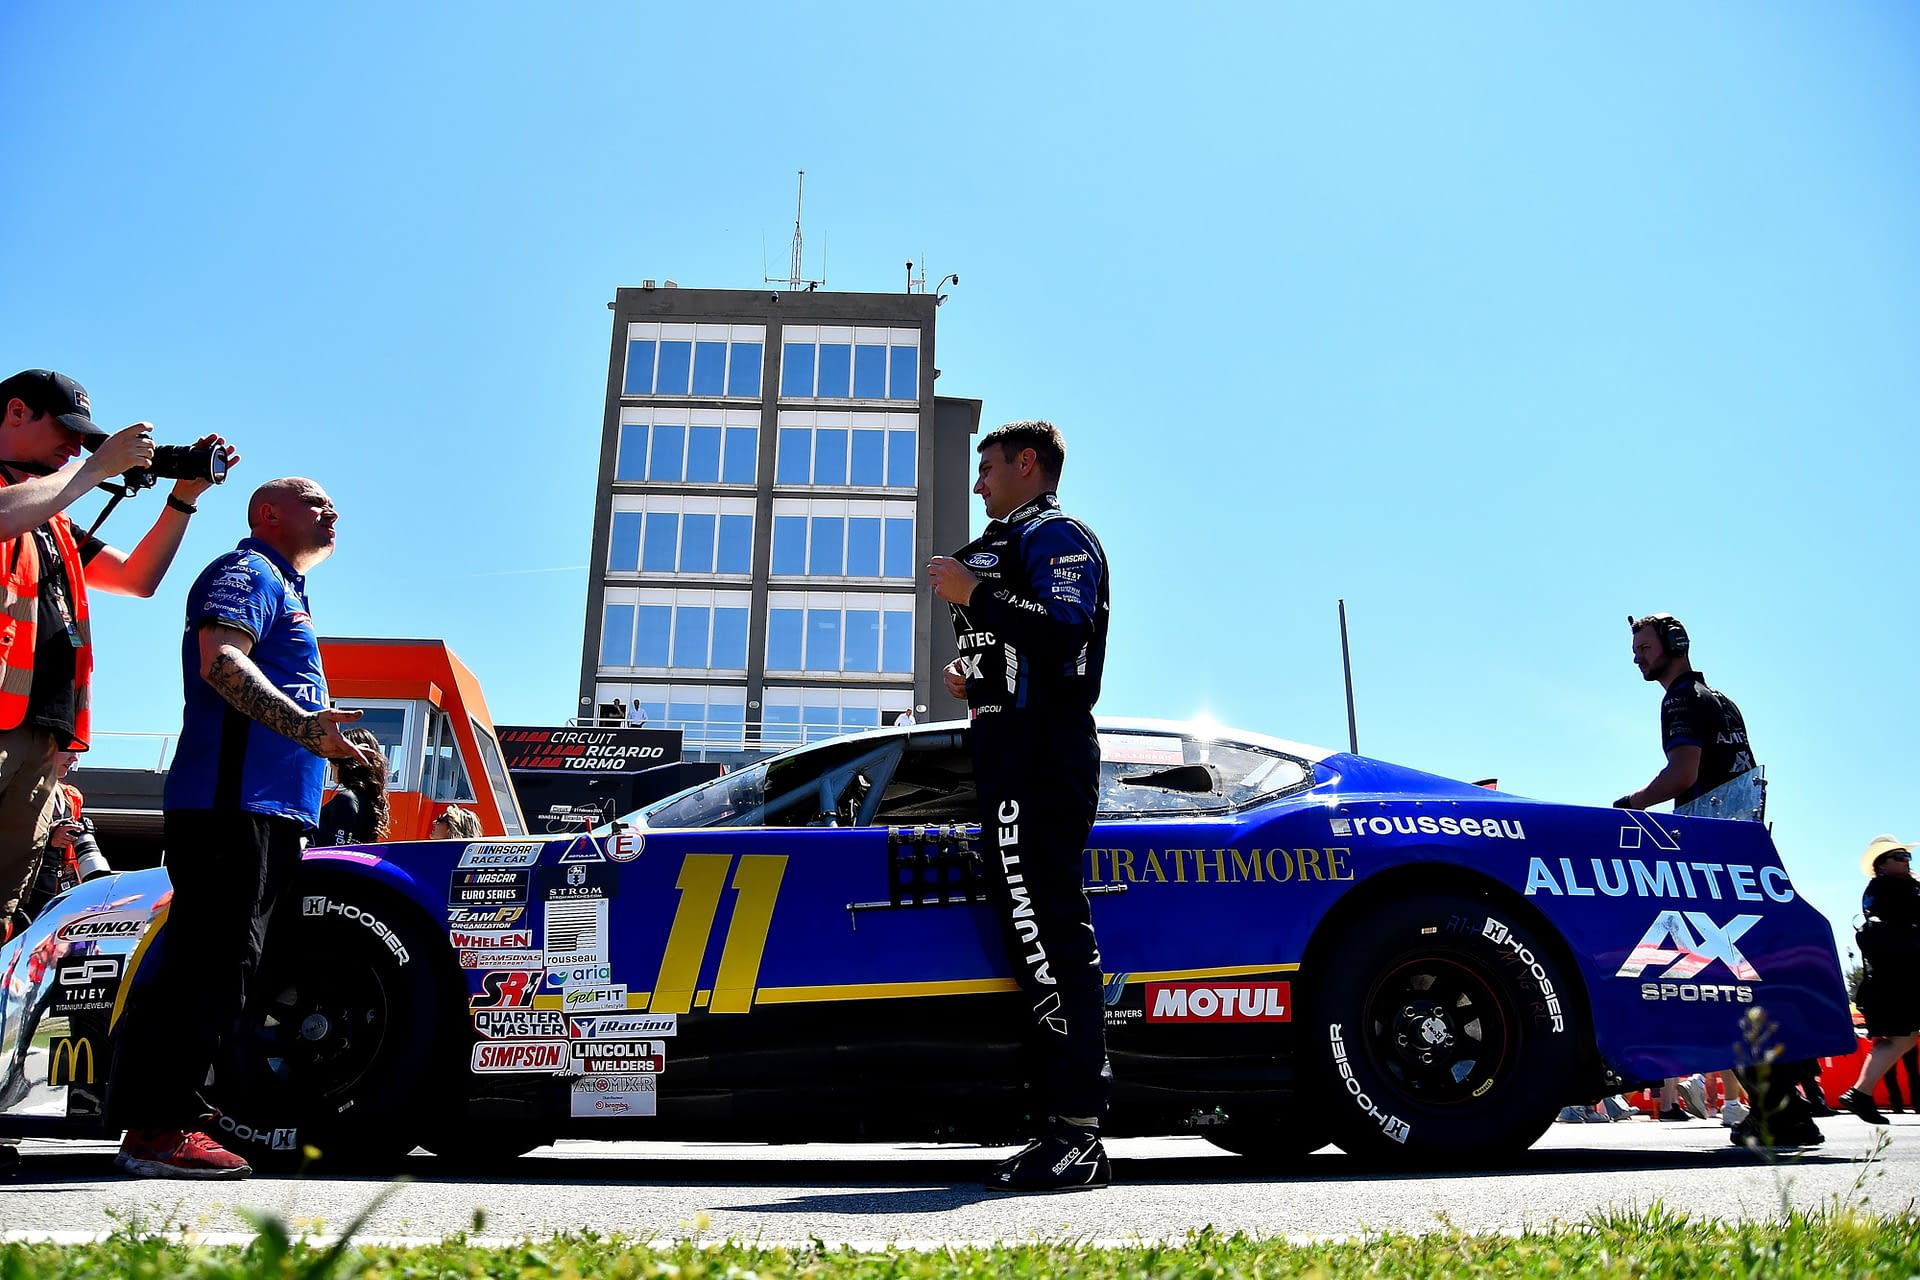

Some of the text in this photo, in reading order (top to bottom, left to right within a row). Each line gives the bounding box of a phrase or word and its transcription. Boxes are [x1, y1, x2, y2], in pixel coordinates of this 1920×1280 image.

[969, 556, 994, 568] Ford
[1059, 554, 1088, 564] NASCAR
[550, 731, 617, 745] CIRCUIT
[585, 745, 665, 759] RICARDO
[564, 757, 626, 771] TORMO
[1353, 815, 1526, 841] rousseau
[487, 845, 532, 855] NASCAR
[615, 835, 634, 855] E
[470, 855, 527, 864] RACE CAR
[476, 873, 517, 884] NASCAR
[1524, 857, 1795, 904] ALUMITEC
[461, 889, 517, 900] EURO SERIES
[549, 886, 603, 896] STROM
[998, 799, 1057, 985] ALUMITEC
[63, 920, 141, 937] KENNOL
[326, 900, 410, 967] HOOSIER
[451, 922, 512, 930] ORGANIZATION
[649, 853, 789, 1014] 11
[451, 932, 529, 948] WHELEN
[1615, 910, 1764, 982] AX
[480, 953, 542, 961] SAMSONAS
[547, 954, 597, 965] rousseau
[572, 965, 610, 981] aria
[1504, 934, 1564, 1034] HOOSIER
[65, 988, 106, 1001] TIJEY
[1641, 983, 1753, 1004] SPORTS
[55, 1001, 113, 1012] TITANIUM JEWELRY
[1152, 988, 1285, 1018] MOTUL
[476, 1012, 560, 1030] QUARTER
[1114, 1010, 1143, 1018] RIVERS
[490, 1023, 564, 1038] MASTER
[597, 1019, 674, 1035] iRacing
[478, 1045, 562, 1068] SIMPSON
[575, 1042, 648, 1058] LINCOLN
[591, 1059, 655, 1072] WELDERS
[1330, 1023, 1389, 1126] HOOSIER
[1051, 1147, 1079, 1174] sparco
